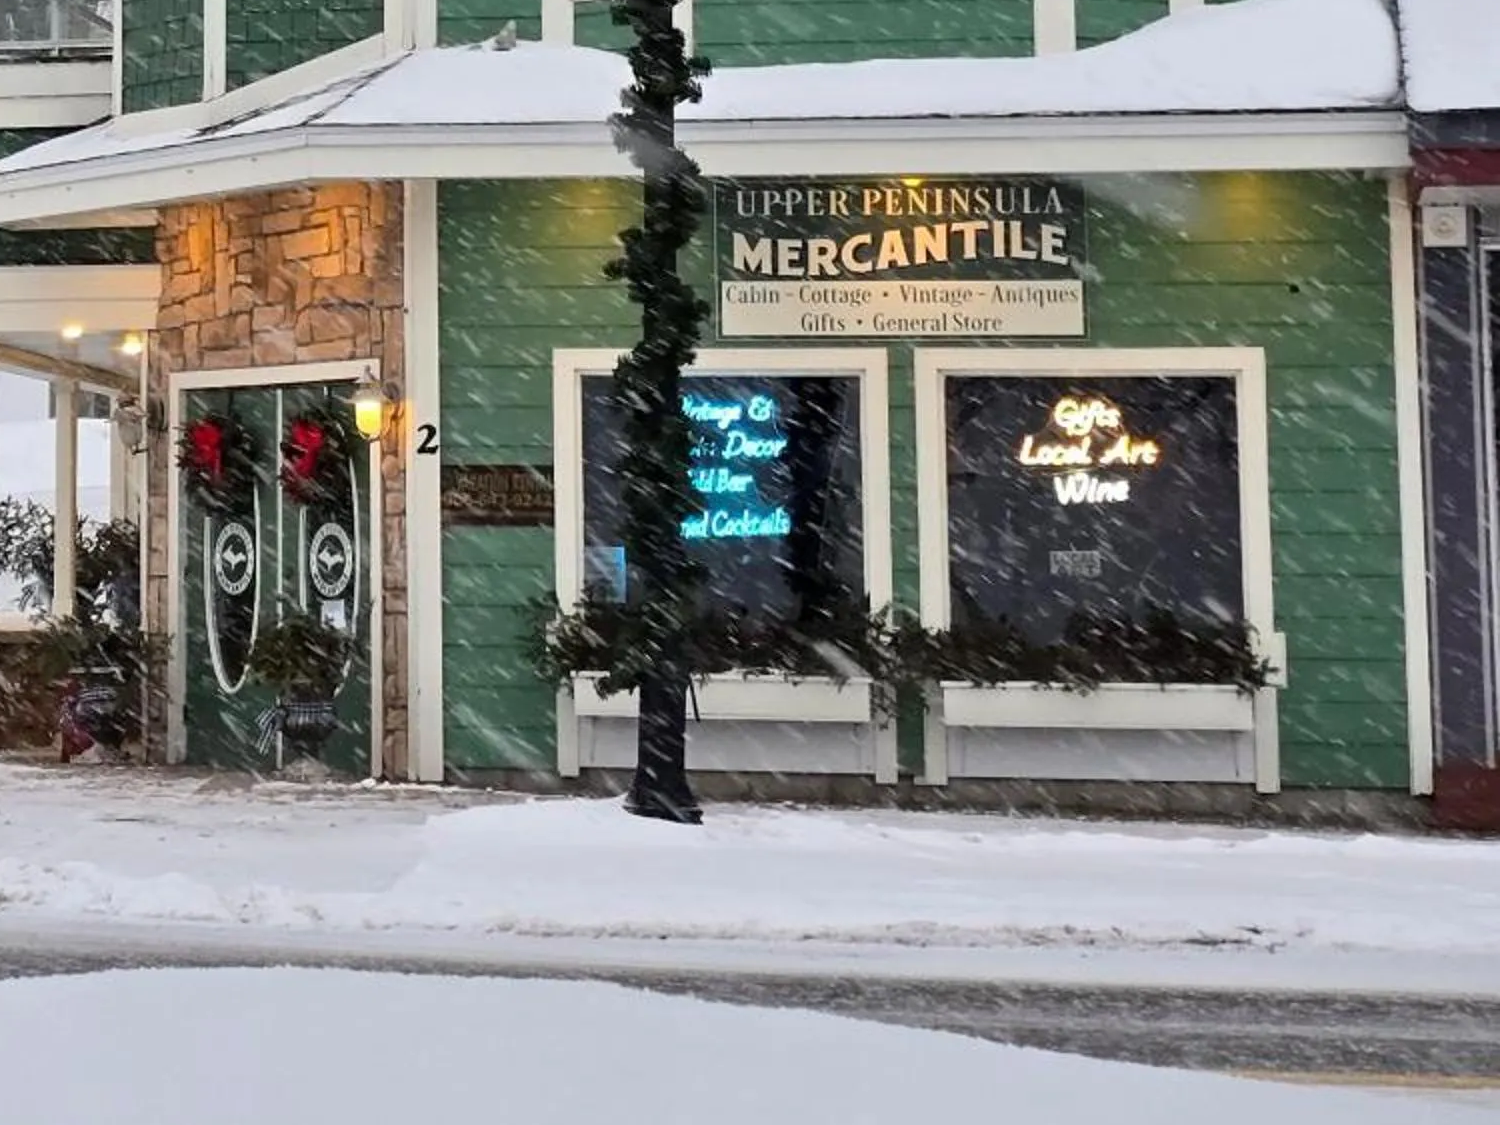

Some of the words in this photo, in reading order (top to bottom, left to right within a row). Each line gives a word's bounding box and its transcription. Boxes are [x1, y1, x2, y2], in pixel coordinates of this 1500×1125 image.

[736, 188, 850, 217] UPPER
[863, 186, 1064, 217] PENINSULA
[732, 220, 1070, 276] MERCANTILE
[726, 284, 780, 304] Cabin
[799, 284, 872, 307] Cottage
[900, 284, 973, 307] Vintage
[991, 284, 1079, 308] Antiques
[801, 312, 846, 332] Gifts
[873, 312, 947, 332] General
[952, 312, 1003, 332] Store
[1053, 397, 1122, 436] Gifts
[416, 424, 439, 455] 2
[1017, 435, 1093, 465] Local
[1100, 435, 1160, 465] Art
[1053, 473, 1130, 506] Wine
